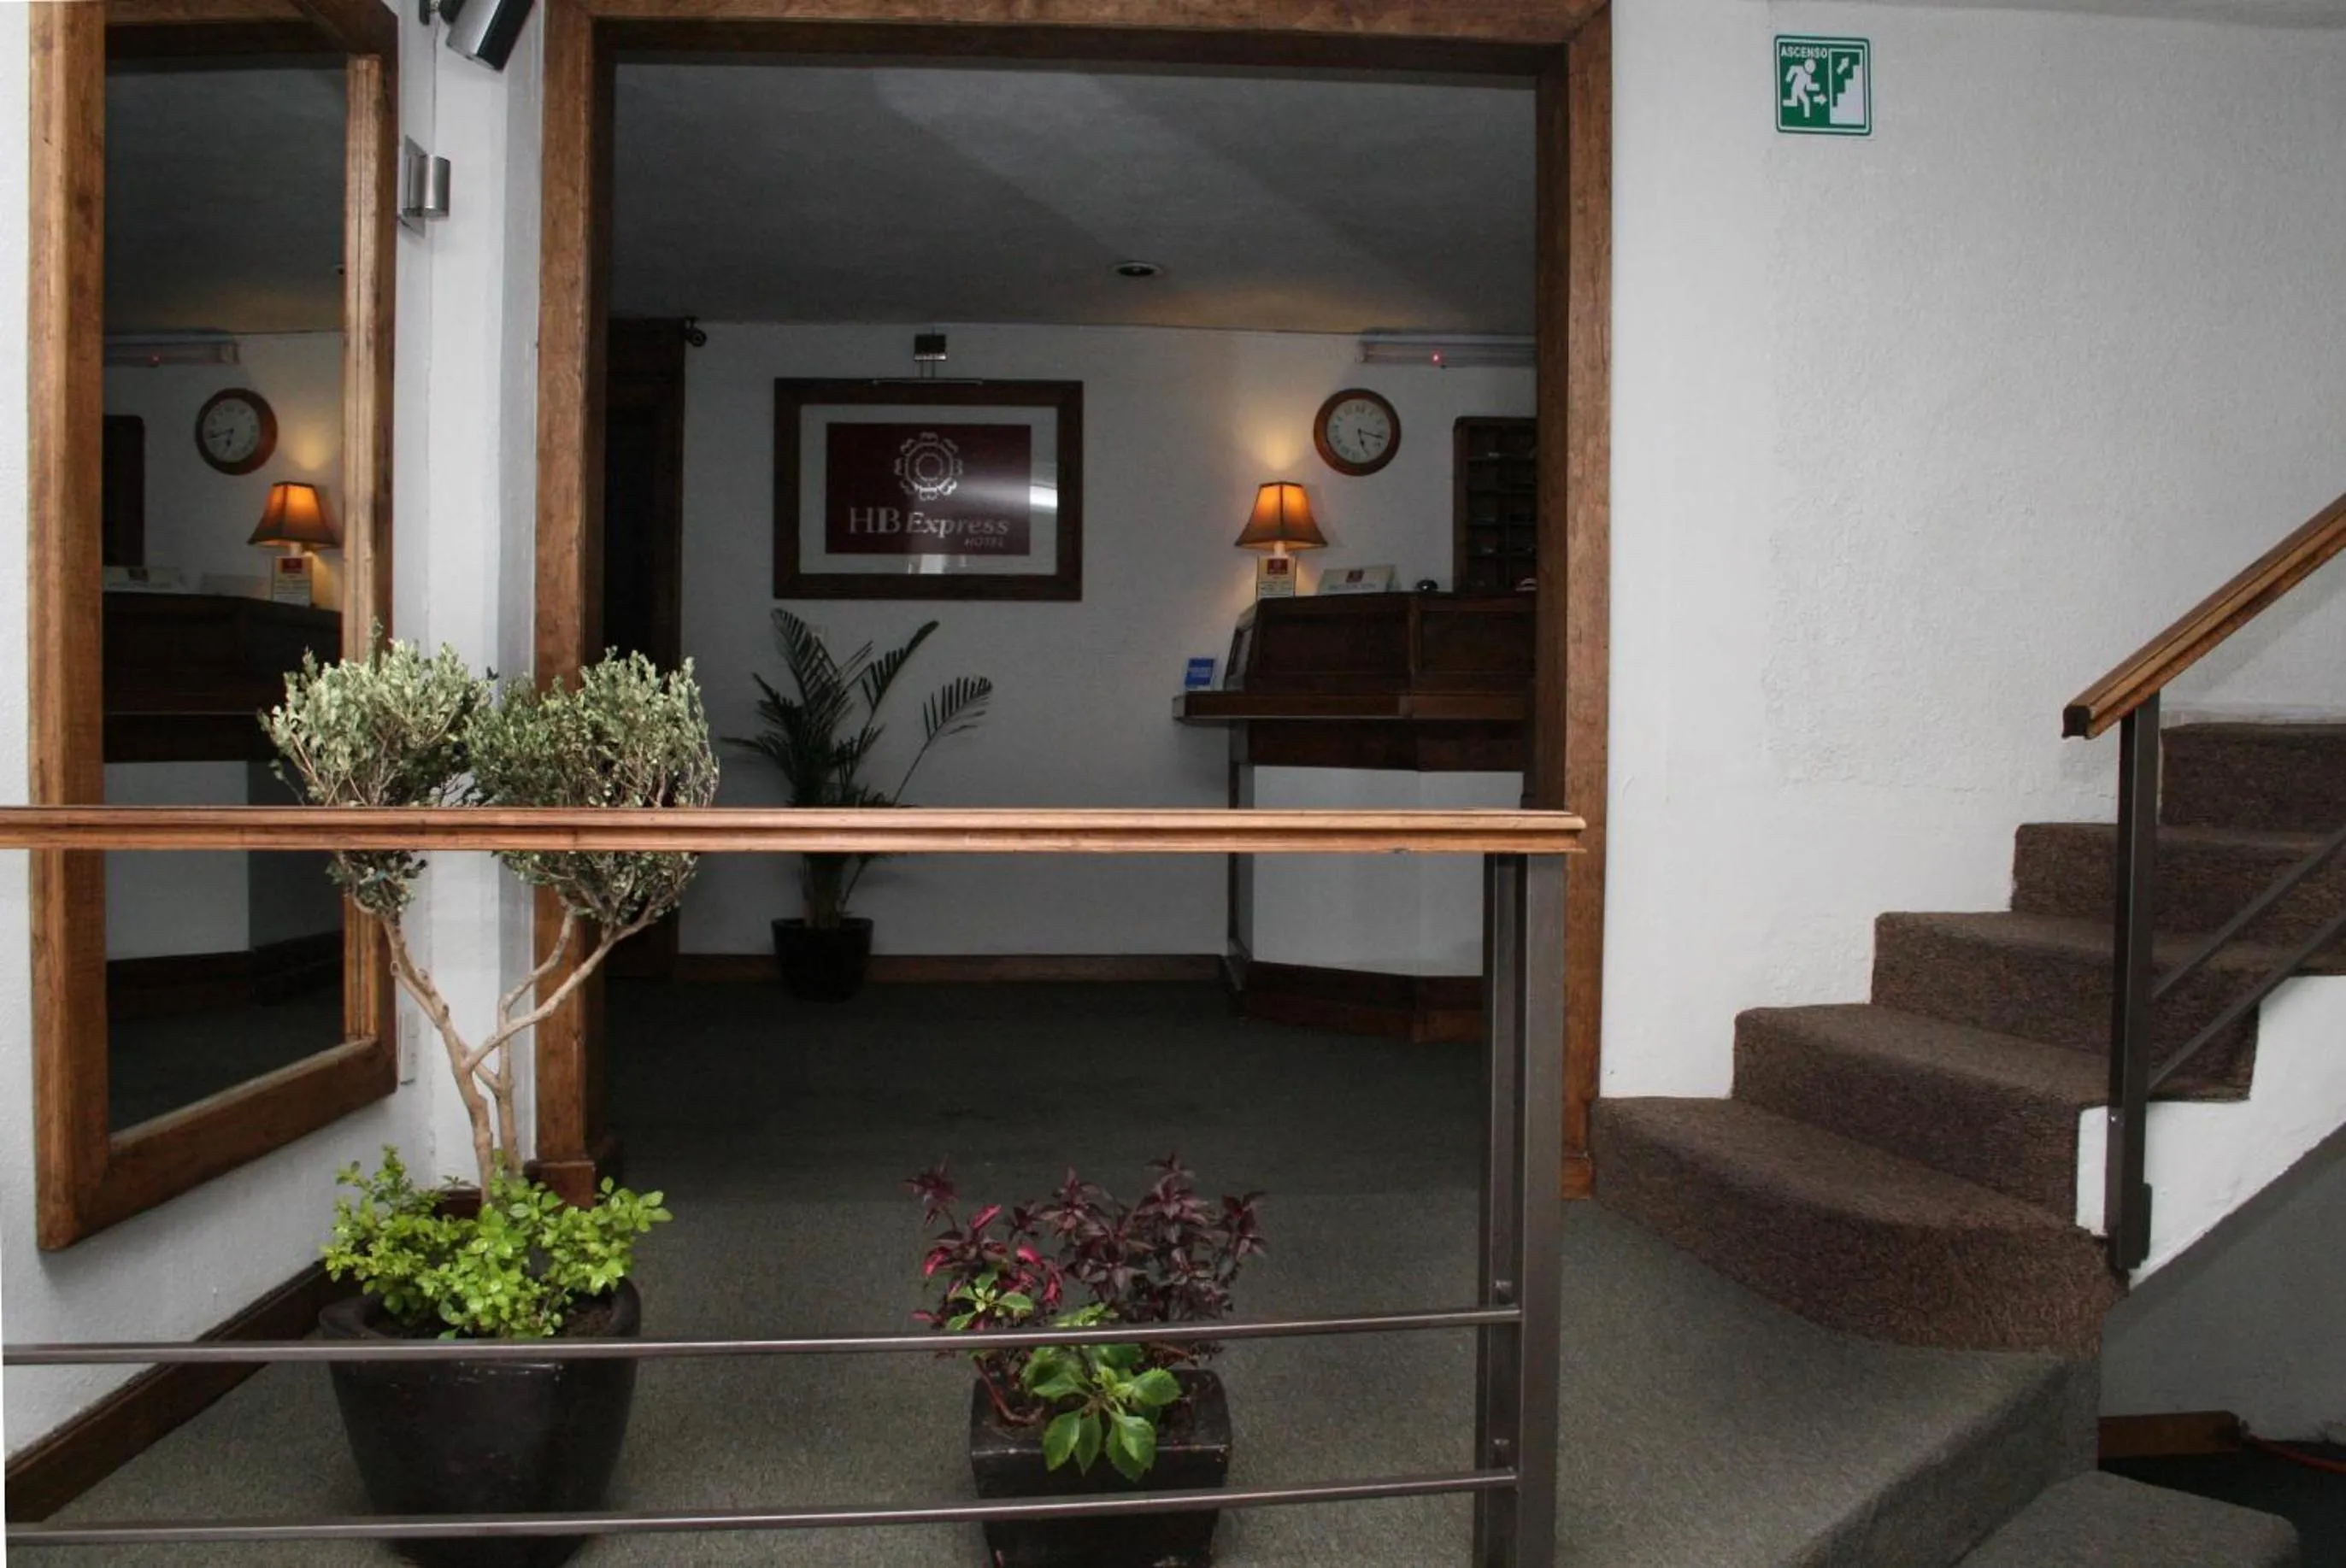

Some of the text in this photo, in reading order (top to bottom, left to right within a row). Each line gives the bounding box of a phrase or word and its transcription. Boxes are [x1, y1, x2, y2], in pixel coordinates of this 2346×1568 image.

[1781, 46, 1827, 58] ASCENSO
[850, 507, 1009, 538] HB Express
